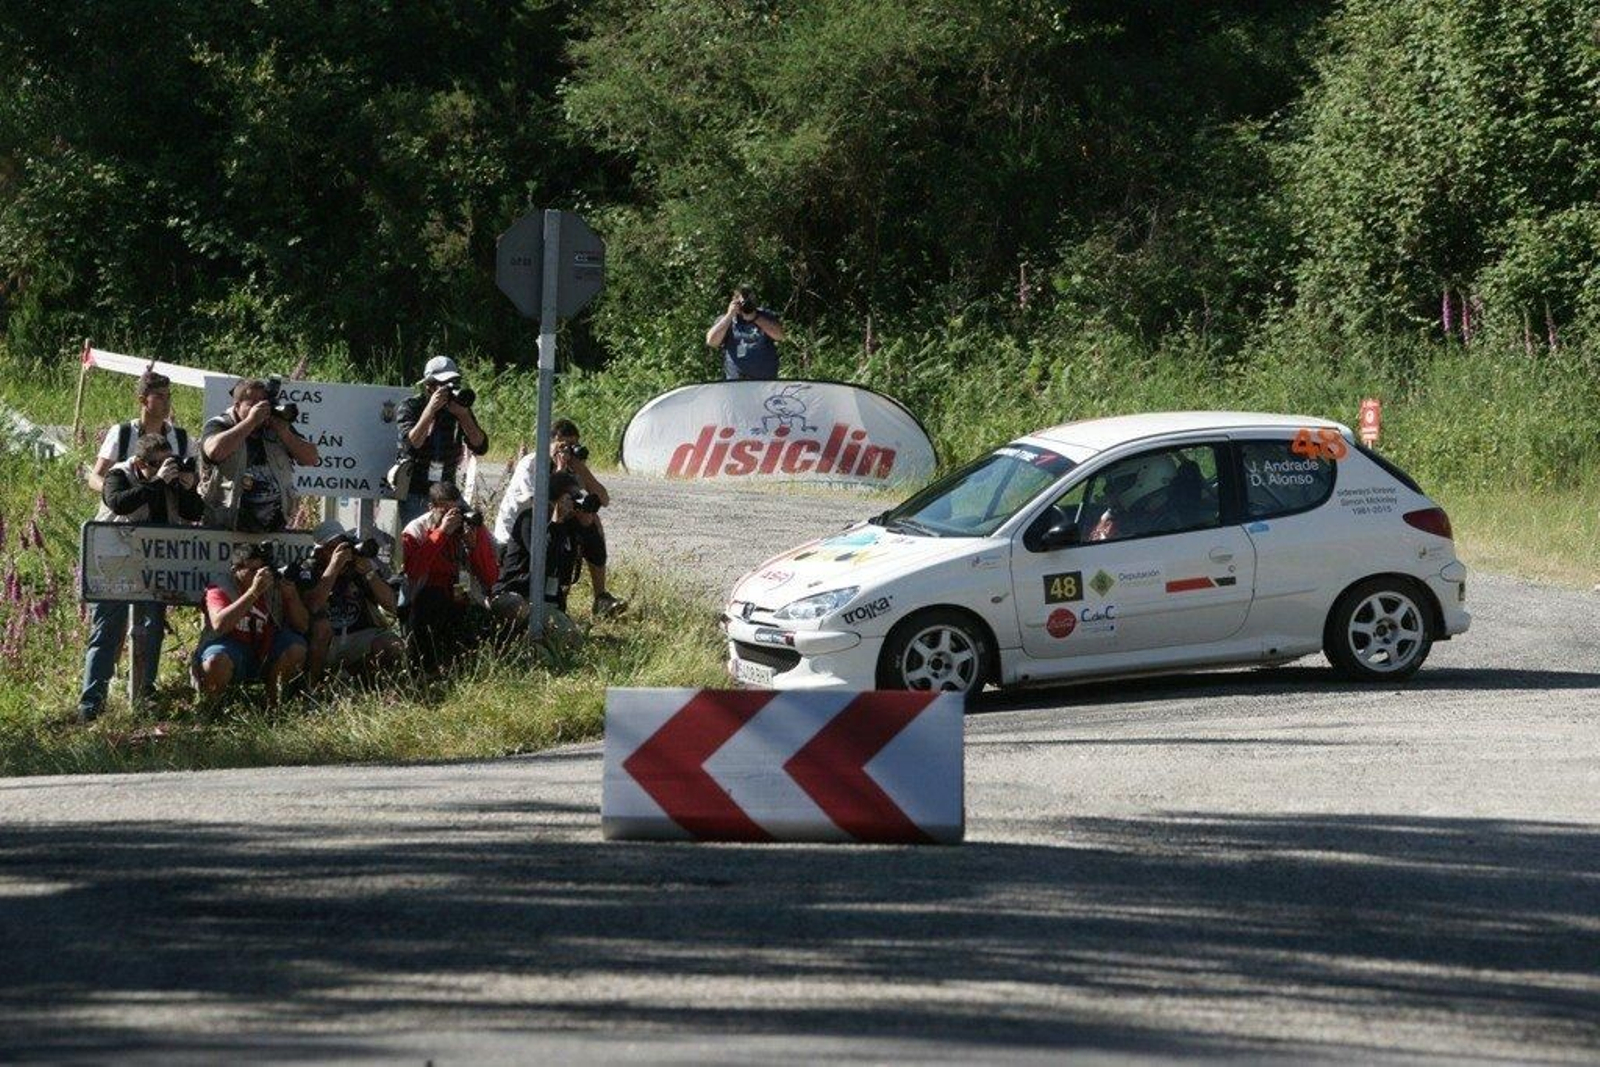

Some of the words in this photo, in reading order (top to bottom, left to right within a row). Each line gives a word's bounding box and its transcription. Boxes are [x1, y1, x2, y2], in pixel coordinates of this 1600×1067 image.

[279, 389, 323, 404] ACAS
[665, 423, 898, 481] disiclin
[1264, 458, 1320, 472] Andrade
[1268, 473, 1314, 486] Alonso
[141, 534, 211, 561] VENTÍN
[141, 566, 211, 591] VENTÍN
[1050, 576, 1077, 599] 48
